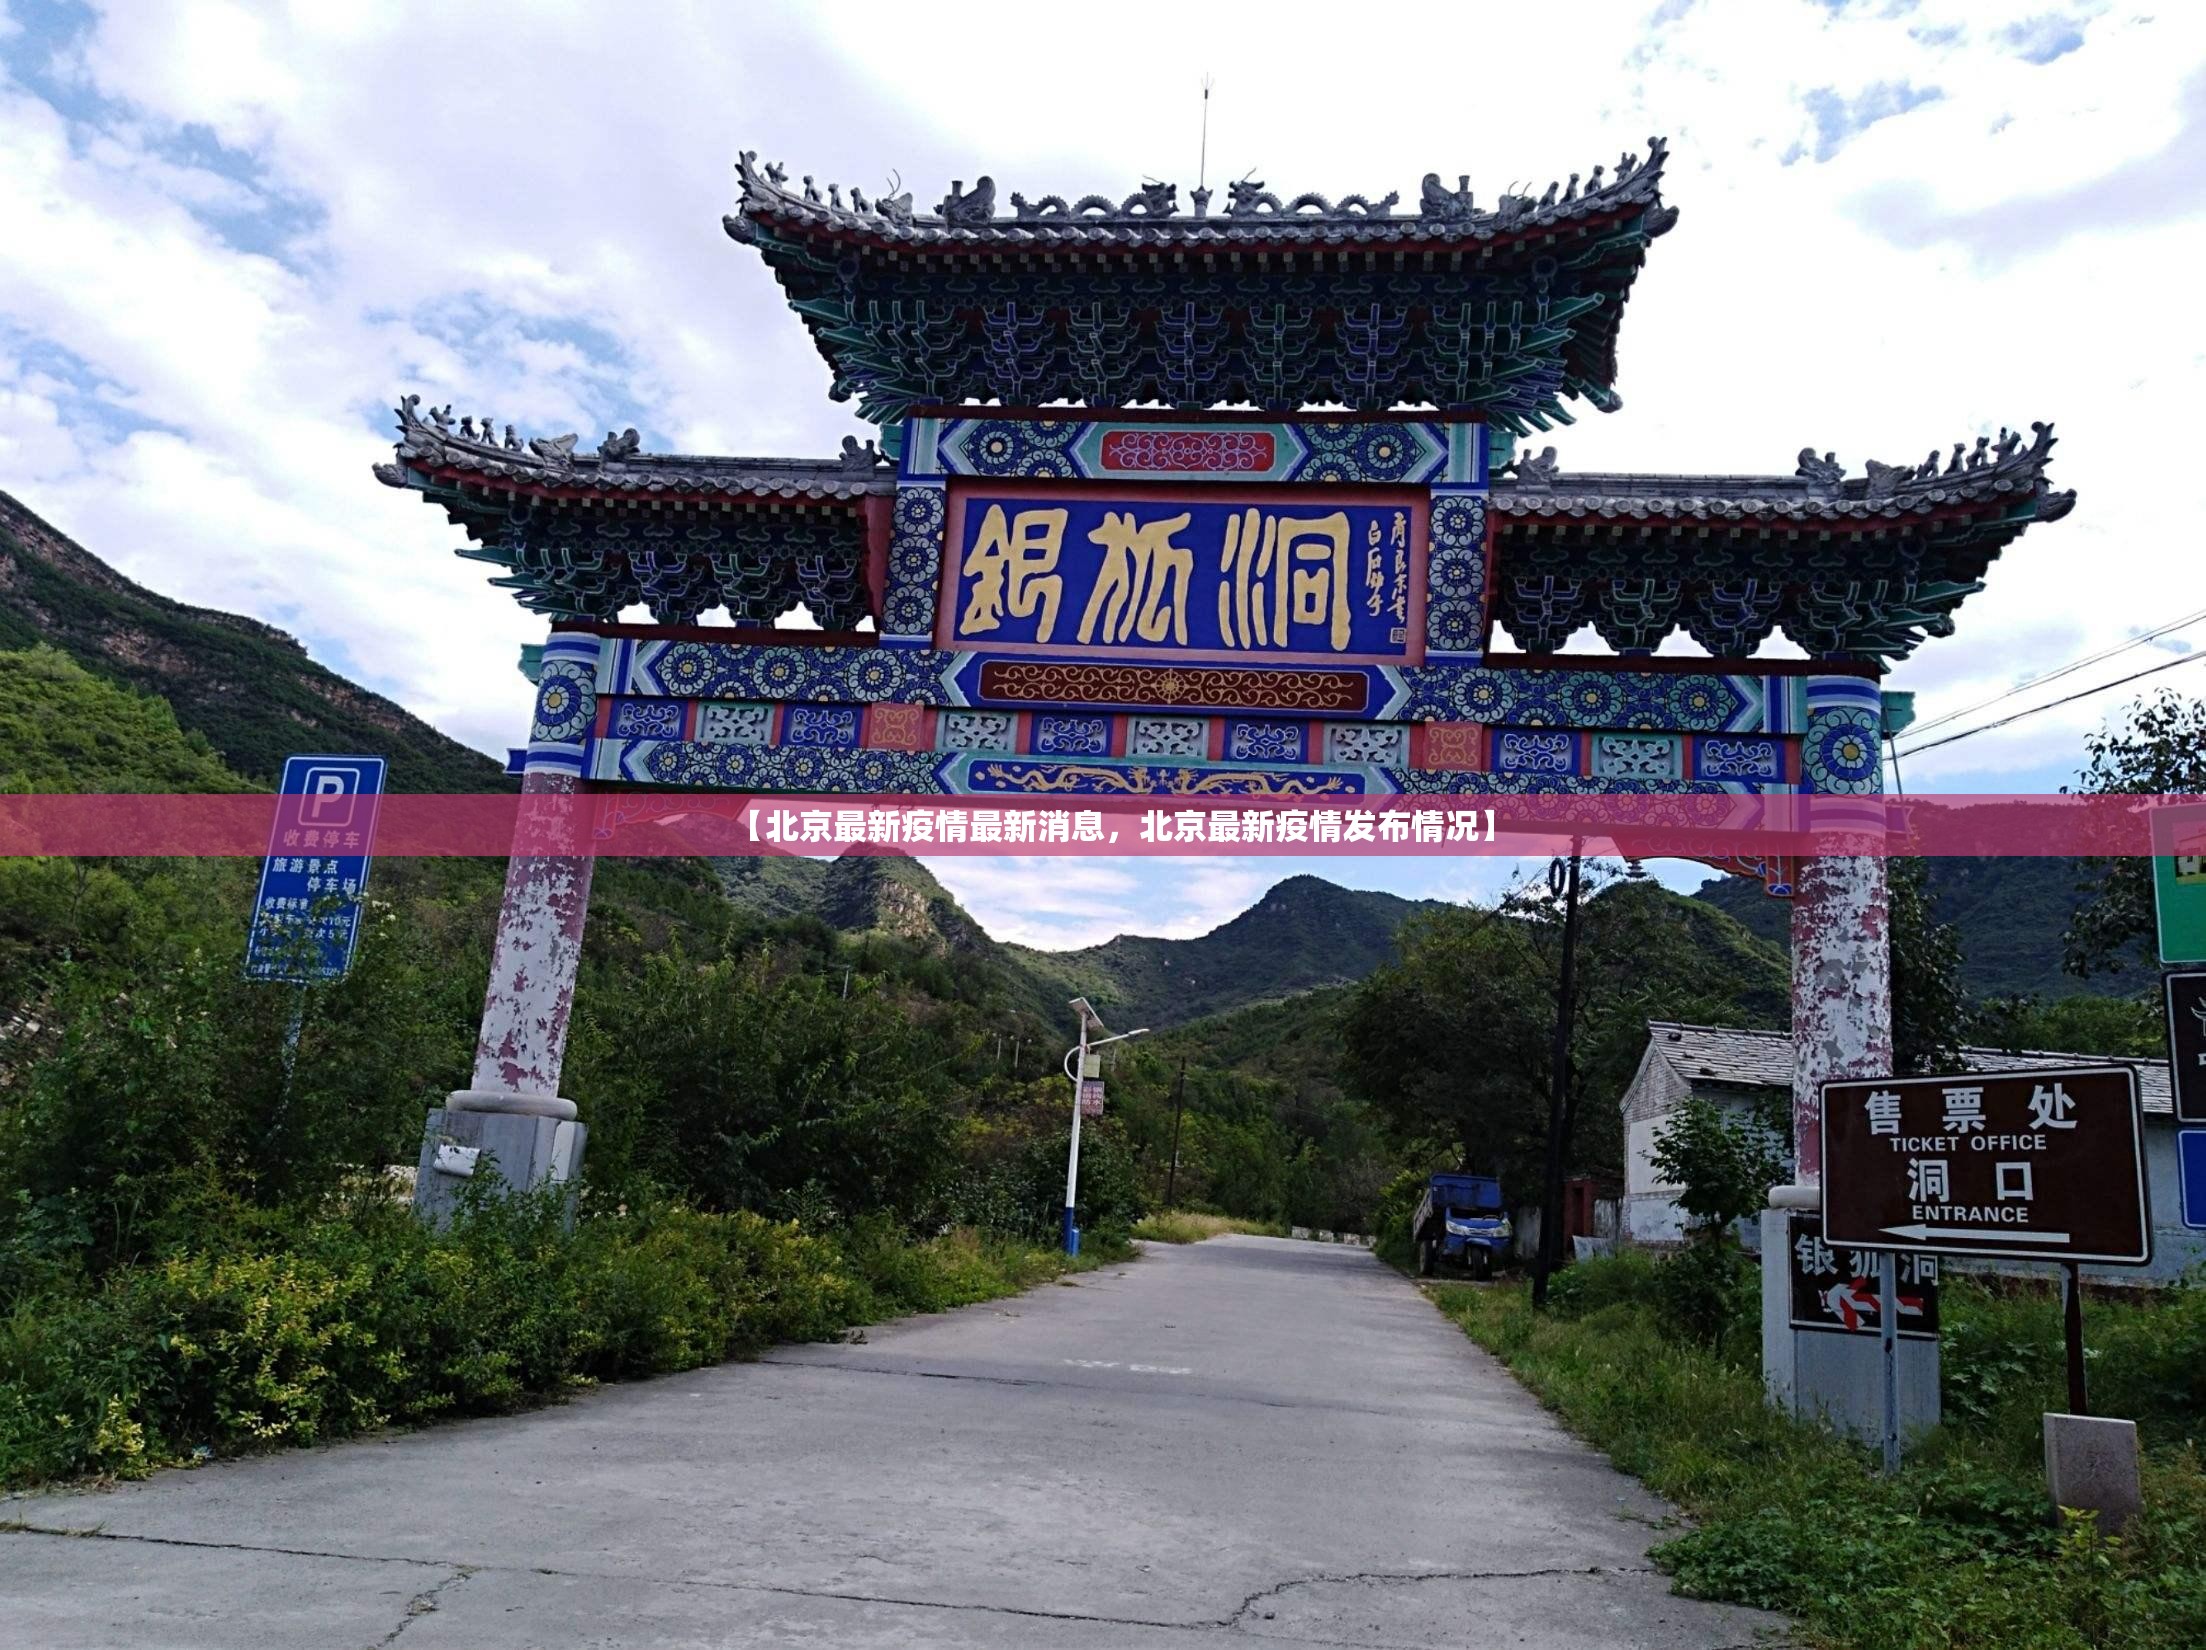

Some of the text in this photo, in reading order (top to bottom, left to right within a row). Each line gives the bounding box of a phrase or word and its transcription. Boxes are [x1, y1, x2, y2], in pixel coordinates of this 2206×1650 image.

[311, 775, 345, 818] P
[283, 829, 361, 848] 收费停车
[272, 857, 338, 874] 旅游景点
[306, 876, 357, 893] 停车场
[1864, 1083, 2078, 1135] 售票处
[1890, 1134, 2047, 1153] TICKET OFFICE
[1907, 1158, 2034, 1203] 洞口
[1912, 1204, 2029, 1224] ENTRANCE
